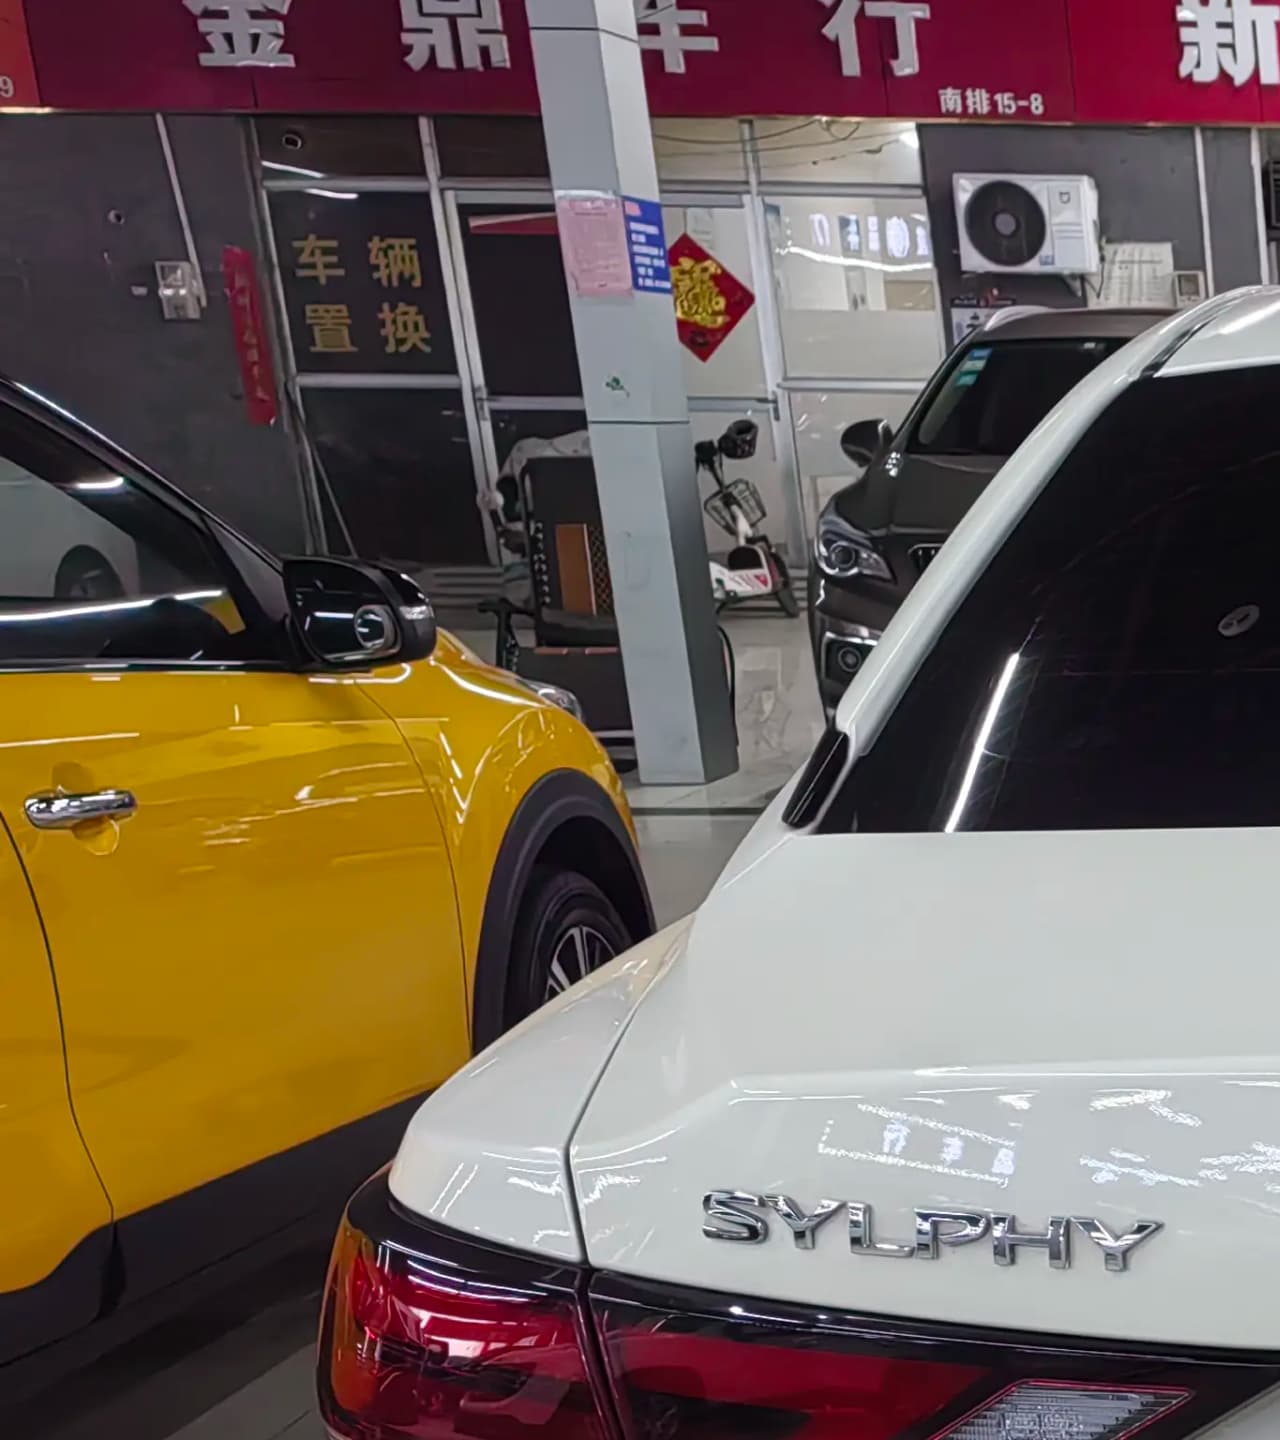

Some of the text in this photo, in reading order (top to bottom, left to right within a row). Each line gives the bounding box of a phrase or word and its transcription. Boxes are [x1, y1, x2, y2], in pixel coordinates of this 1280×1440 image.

[938, 87, 1045, 115] 南排15-8
[292, 234, 423, 288] 车辆
[304, 301, 433, 353] 置换
[701, 1189, 1165, 1273] SYLPHY
